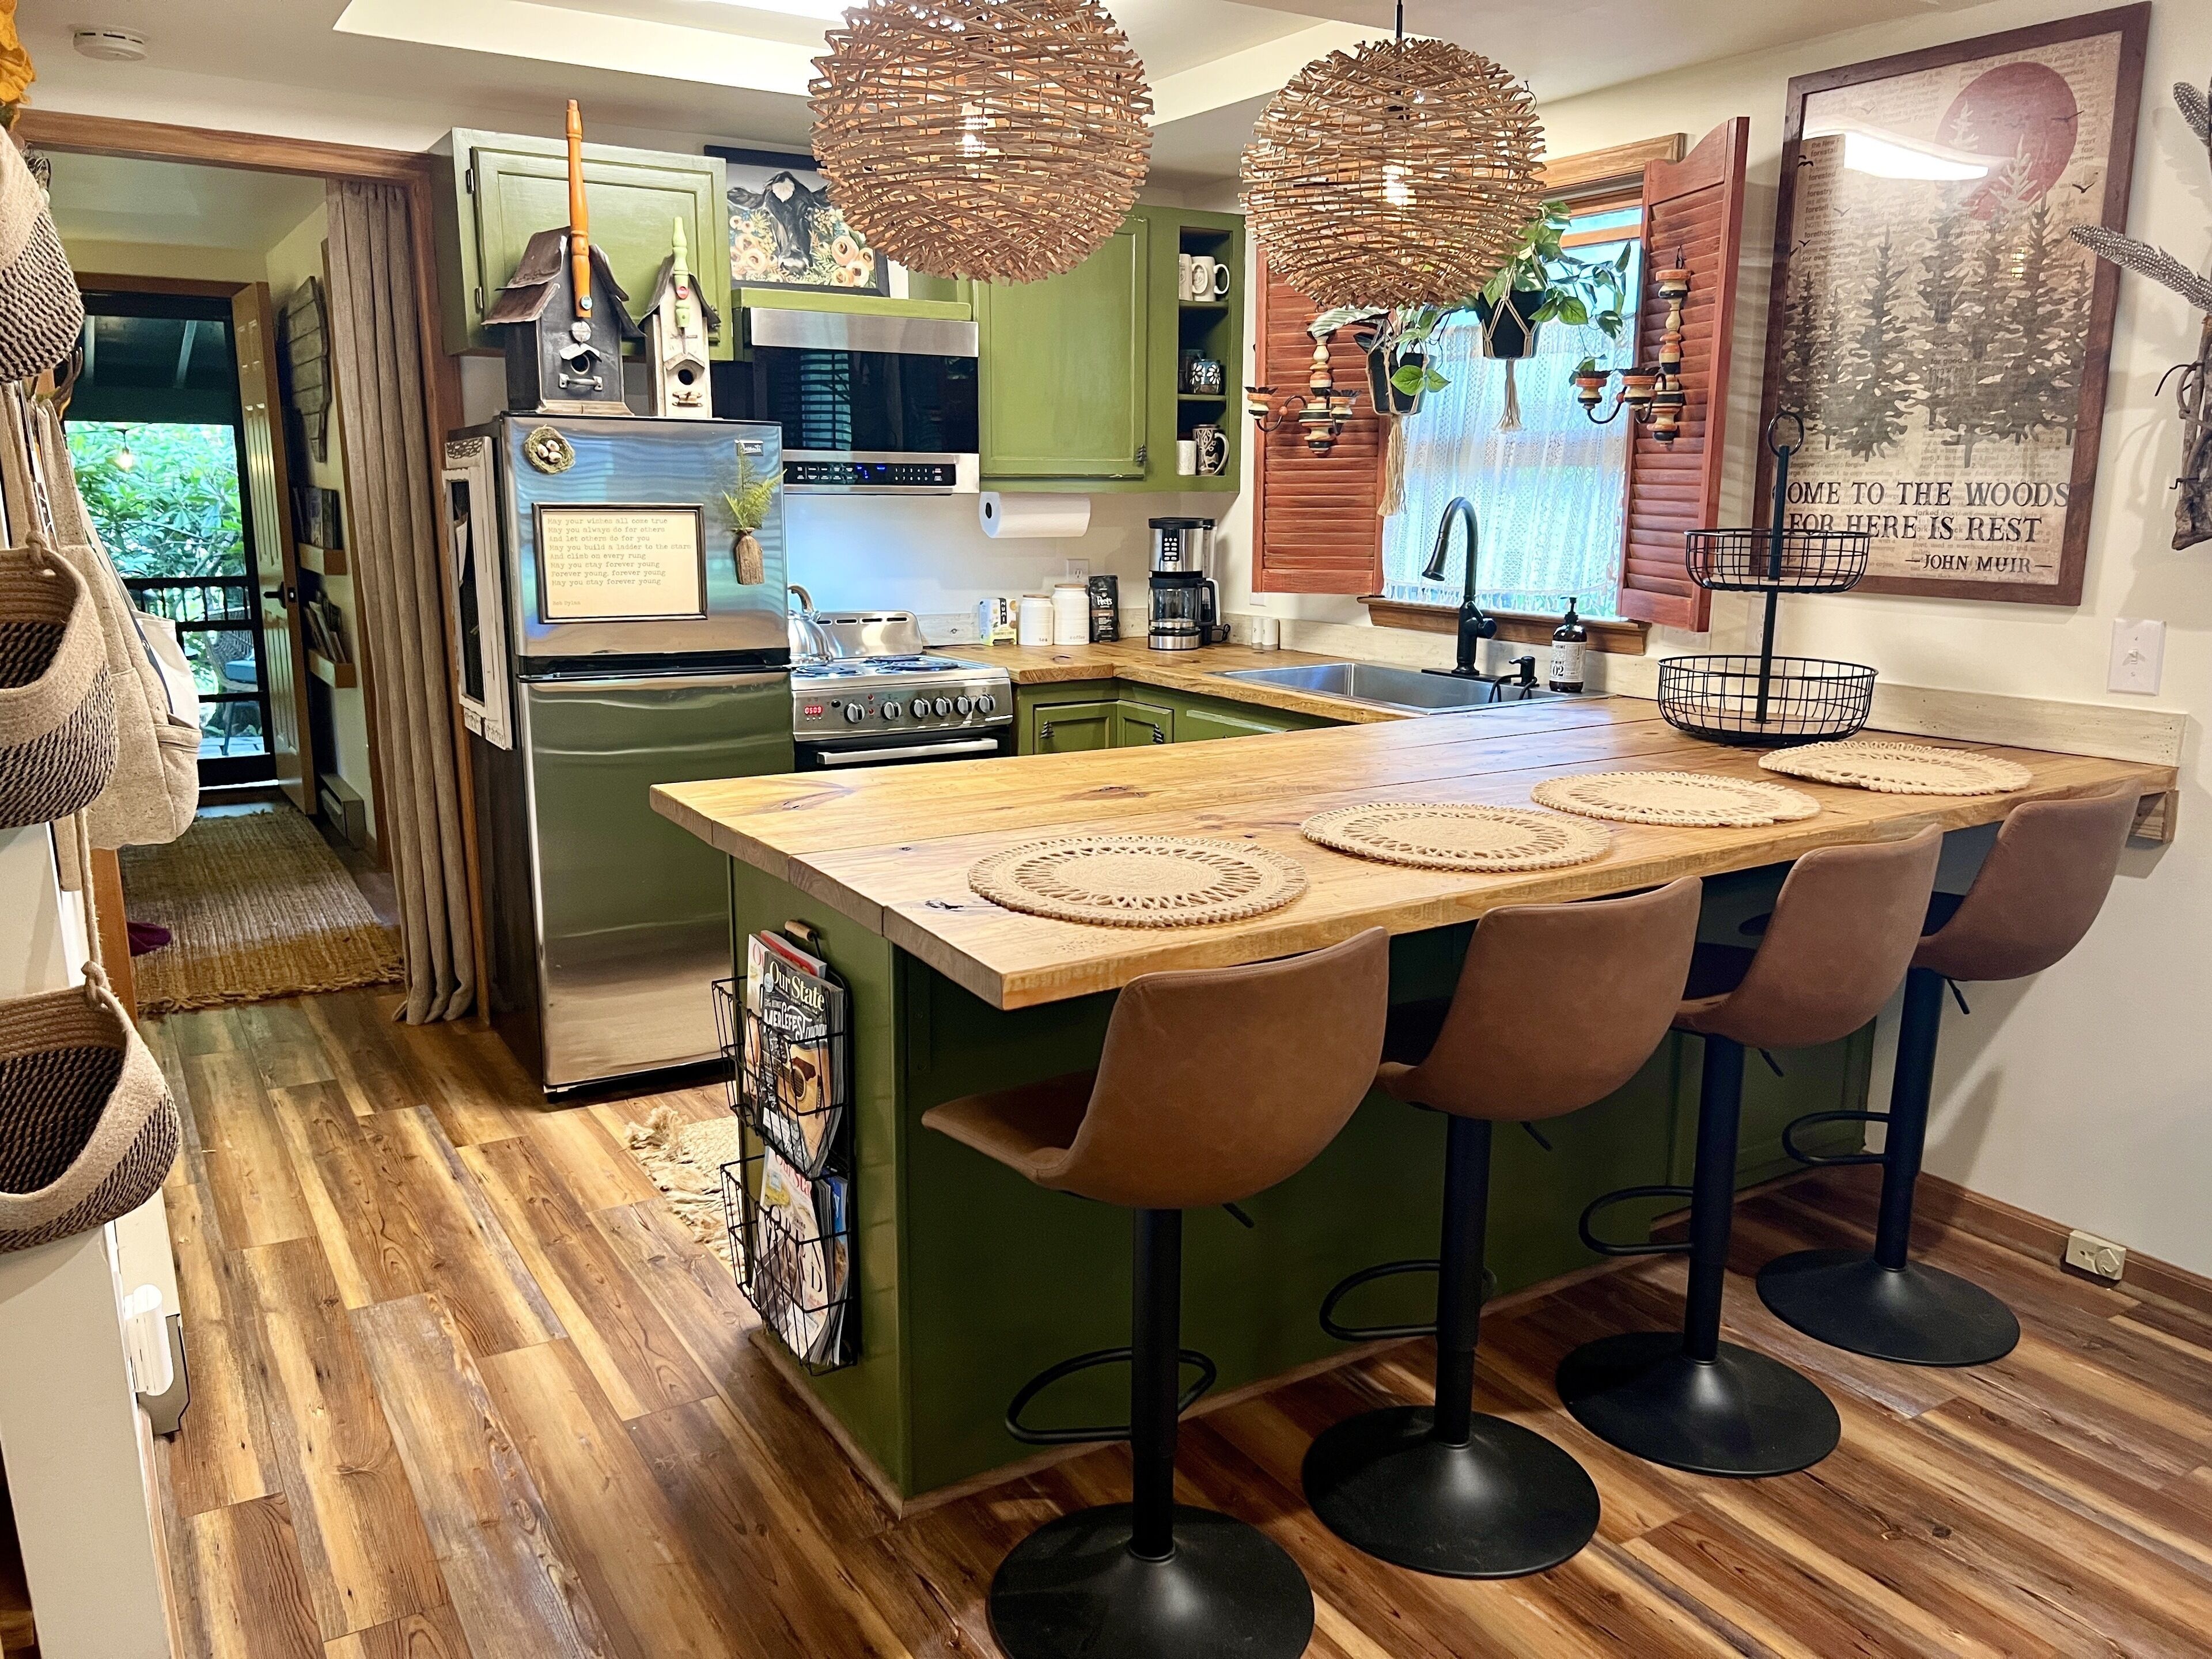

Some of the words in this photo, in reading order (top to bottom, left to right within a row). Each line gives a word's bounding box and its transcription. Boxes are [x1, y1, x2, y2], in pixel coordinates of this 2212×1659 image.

[1772, 482, 1841, 505] OME
[1851, 481, 1885, 505] TO
[1896, 482, 1953, 506] THE
[1964, 482, 2070, 507] WOODS
[1789, 513, 1834, 535] FOR
[1846, 514, 1918, 539] HERE
[1927, 516, 1955, 540] IS
[1964, 516, 2043, 543] REST
[1552, 665, 1564, 677] 02
[770, 961, 791, 993] Our
[791, 975, 825, 1012] State
[764, 1001, 813, 1041] MERLEFEST
